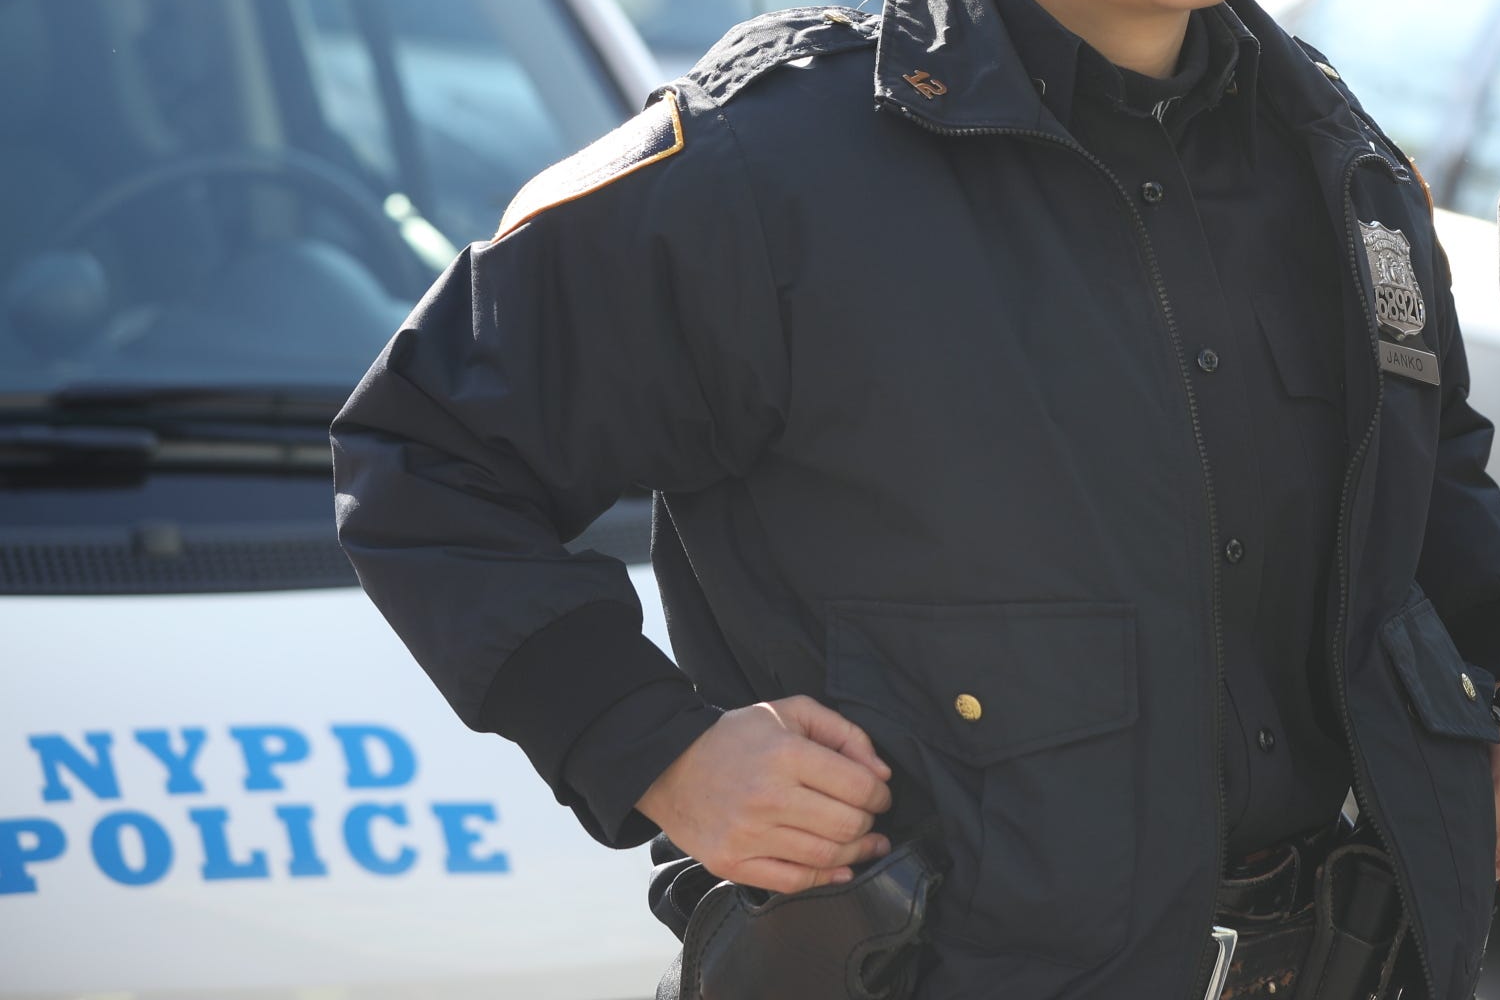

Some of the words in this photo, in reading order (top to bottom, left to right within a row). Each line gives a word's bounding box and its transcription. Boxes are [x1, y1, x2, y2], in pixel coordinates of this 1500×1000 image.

[903, 69, 948, 99] 12
[1386, 351, 1424, 372] JANKO
[26, 723, 419, 803] NYPD
[0, 800, 513, 896] POLICE
